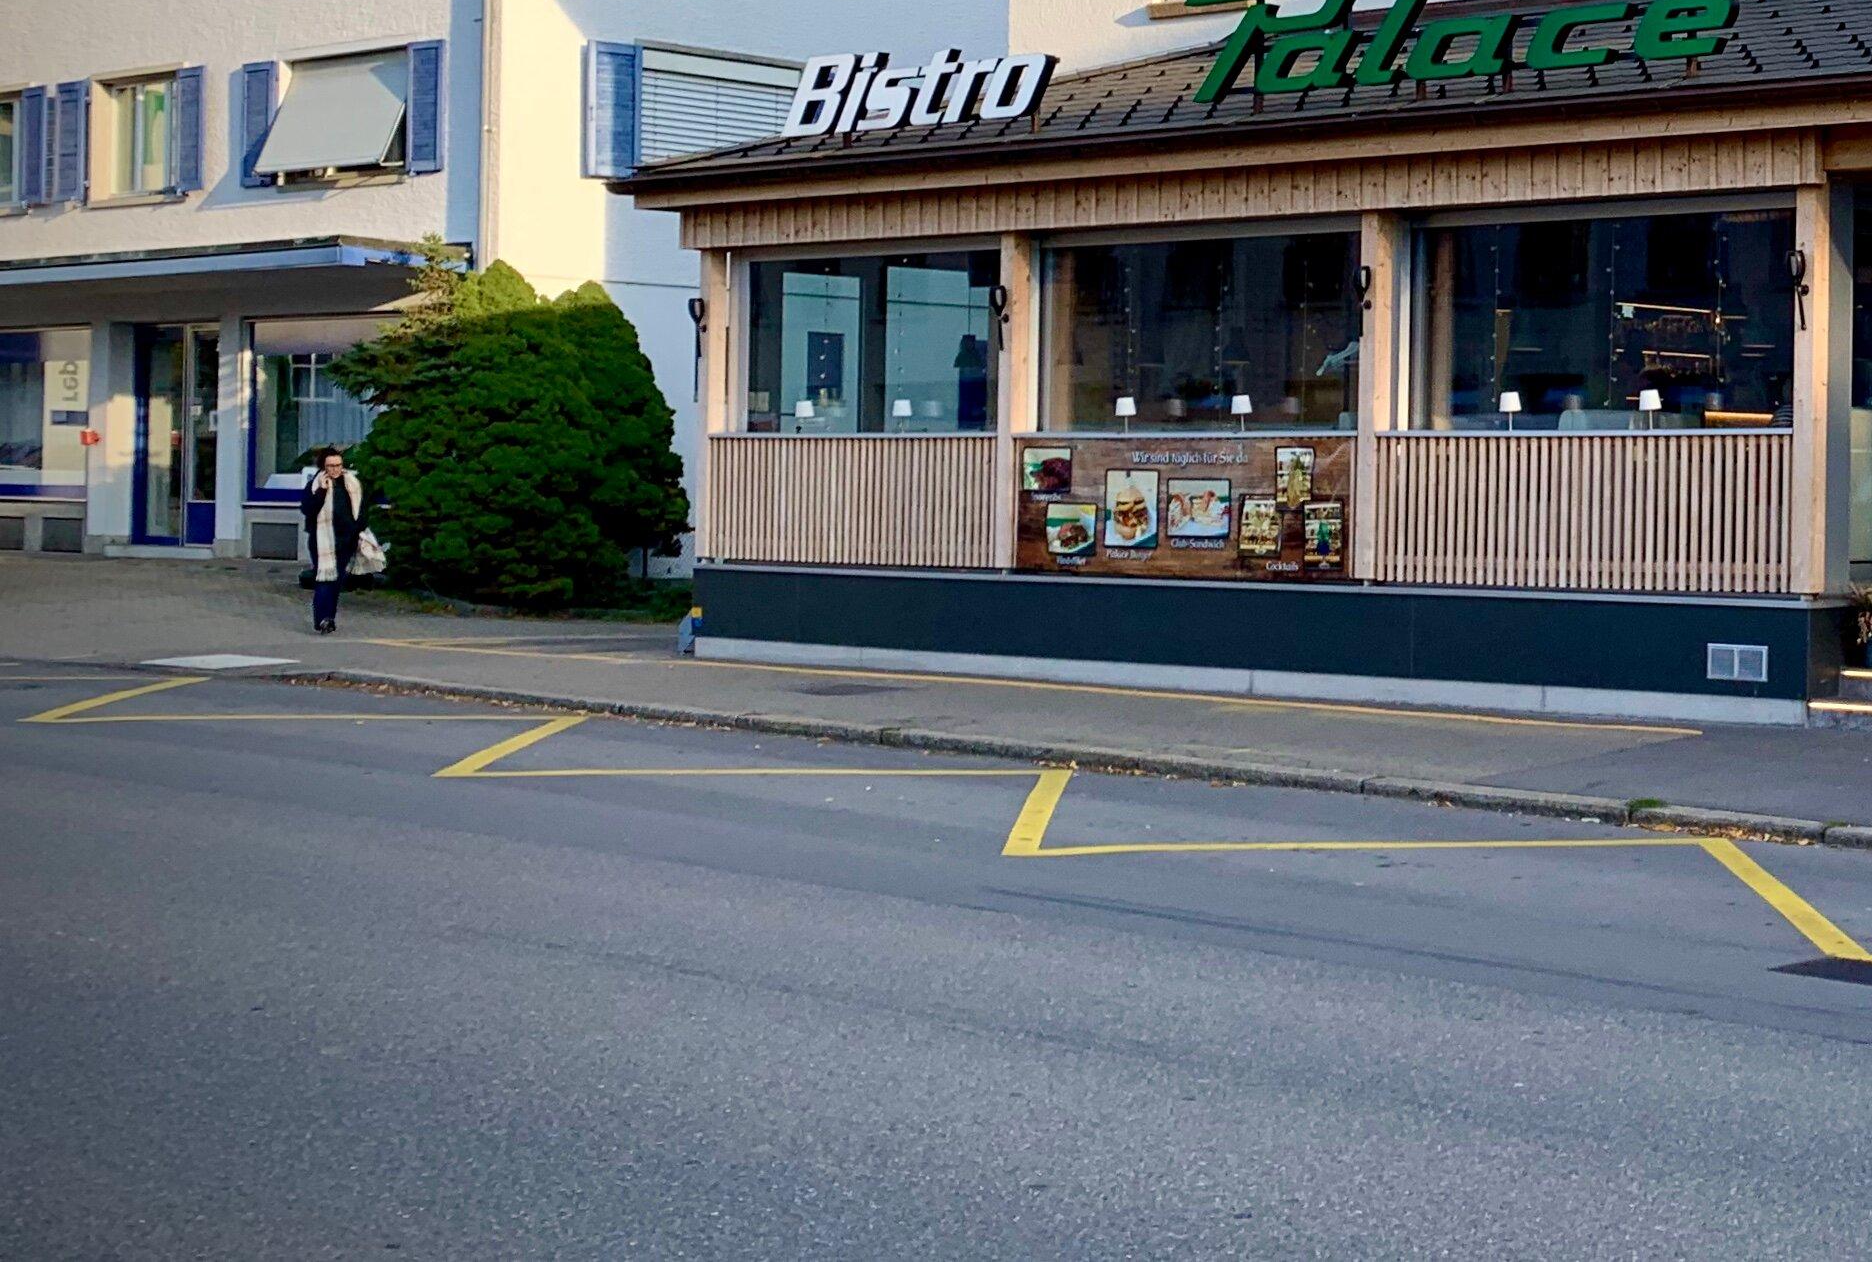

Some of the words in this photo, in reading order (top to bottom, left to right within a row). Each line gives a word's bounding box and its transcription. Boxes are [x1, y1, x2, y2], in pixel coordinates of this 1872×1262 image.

[783, 50, 1060, 137] Bistro
[1131, 451, 1148, 464] Wir
[1149, 451, 1169, 464] sind
